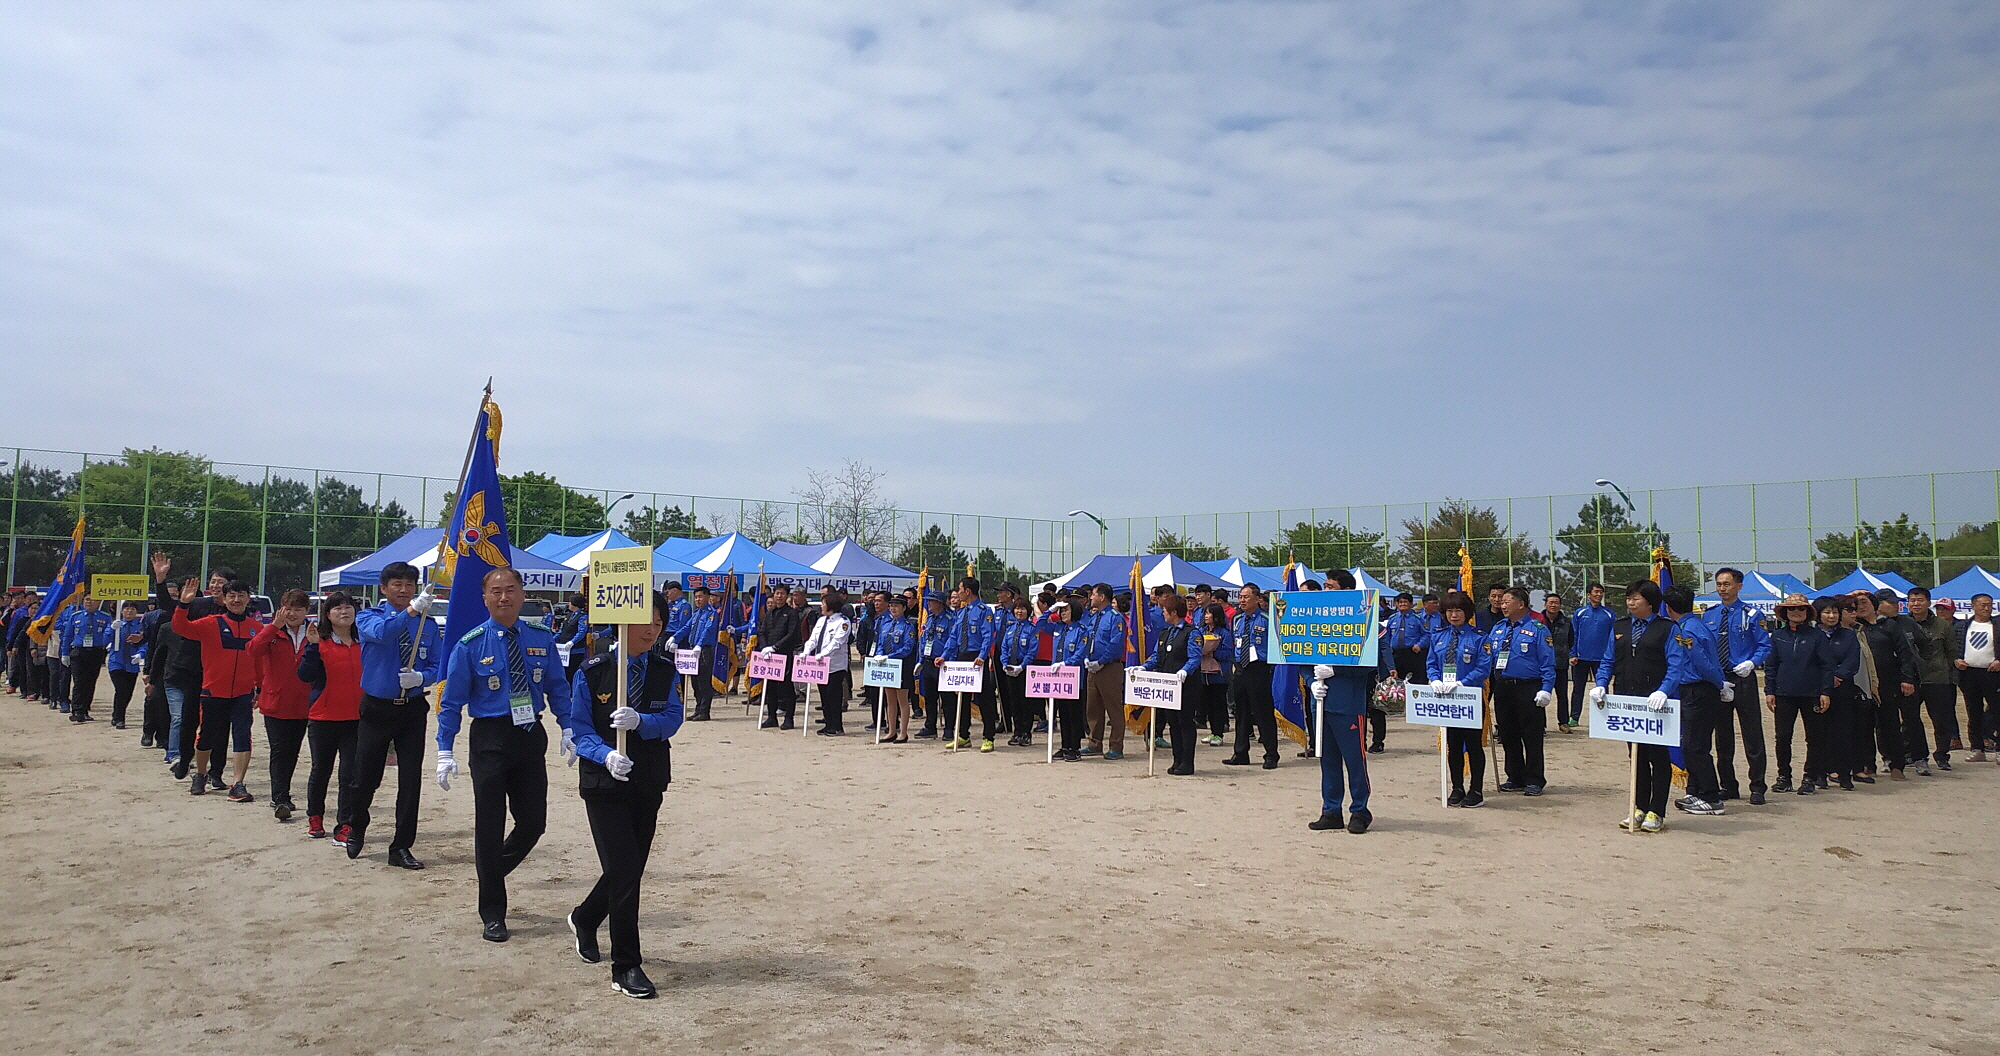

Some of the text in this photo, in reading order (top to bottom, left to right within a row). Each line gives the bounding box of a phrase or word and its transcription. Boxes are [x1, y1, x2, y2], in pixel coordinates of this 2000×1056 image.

[98, 588, 142, 597] 선부1지대
[596, 583, 644, 609] 초지2지대
[1291, 606, 1354, 617] 안산시 자율방범대
[1280, 623, 1366, 637] 제6회 단원연합대
[1282, 642, 1361, 657] 한마음 체육대회
[753, 665, 781, 678] 중앙지대
[871, 670, 895, 682] 원곡지대
[947, 675, 975, 687] 신길지대
[1133, 686, 1173, 702] 백운1지대
[1415, 702, 1474, 720] 단원연합대
[1606, 715, 1664, 736] 풍전지대
